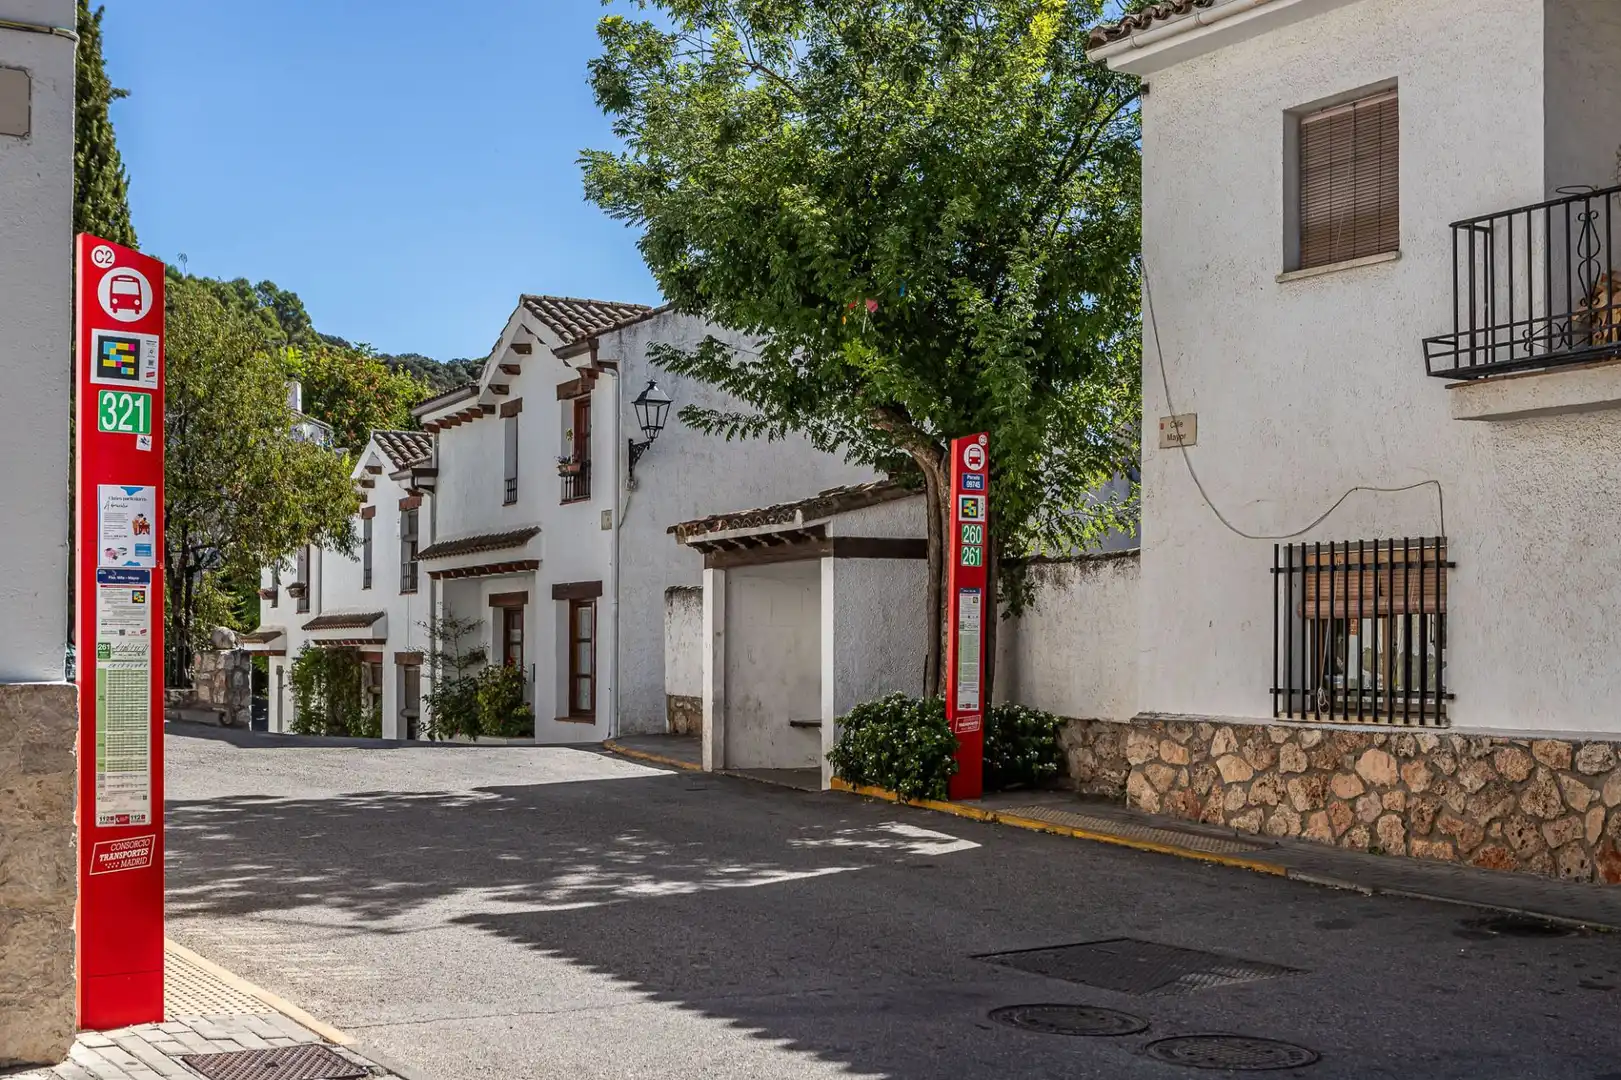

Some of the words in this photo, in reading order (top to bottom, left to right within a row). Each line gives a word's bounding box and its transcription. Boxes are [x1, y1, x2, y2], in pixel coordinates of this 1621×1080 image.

[94, 249, 113, 264] C2
[101, 392, 144, 432] 321
[963, 525, 982, 544] 260
[962, 546, 980, 565] 261
[110, 838, 150, 852] CONSORCIO
[99, 847, 149, 862] TRANSPORTES
[120, 856, 148, 868] MADRID
